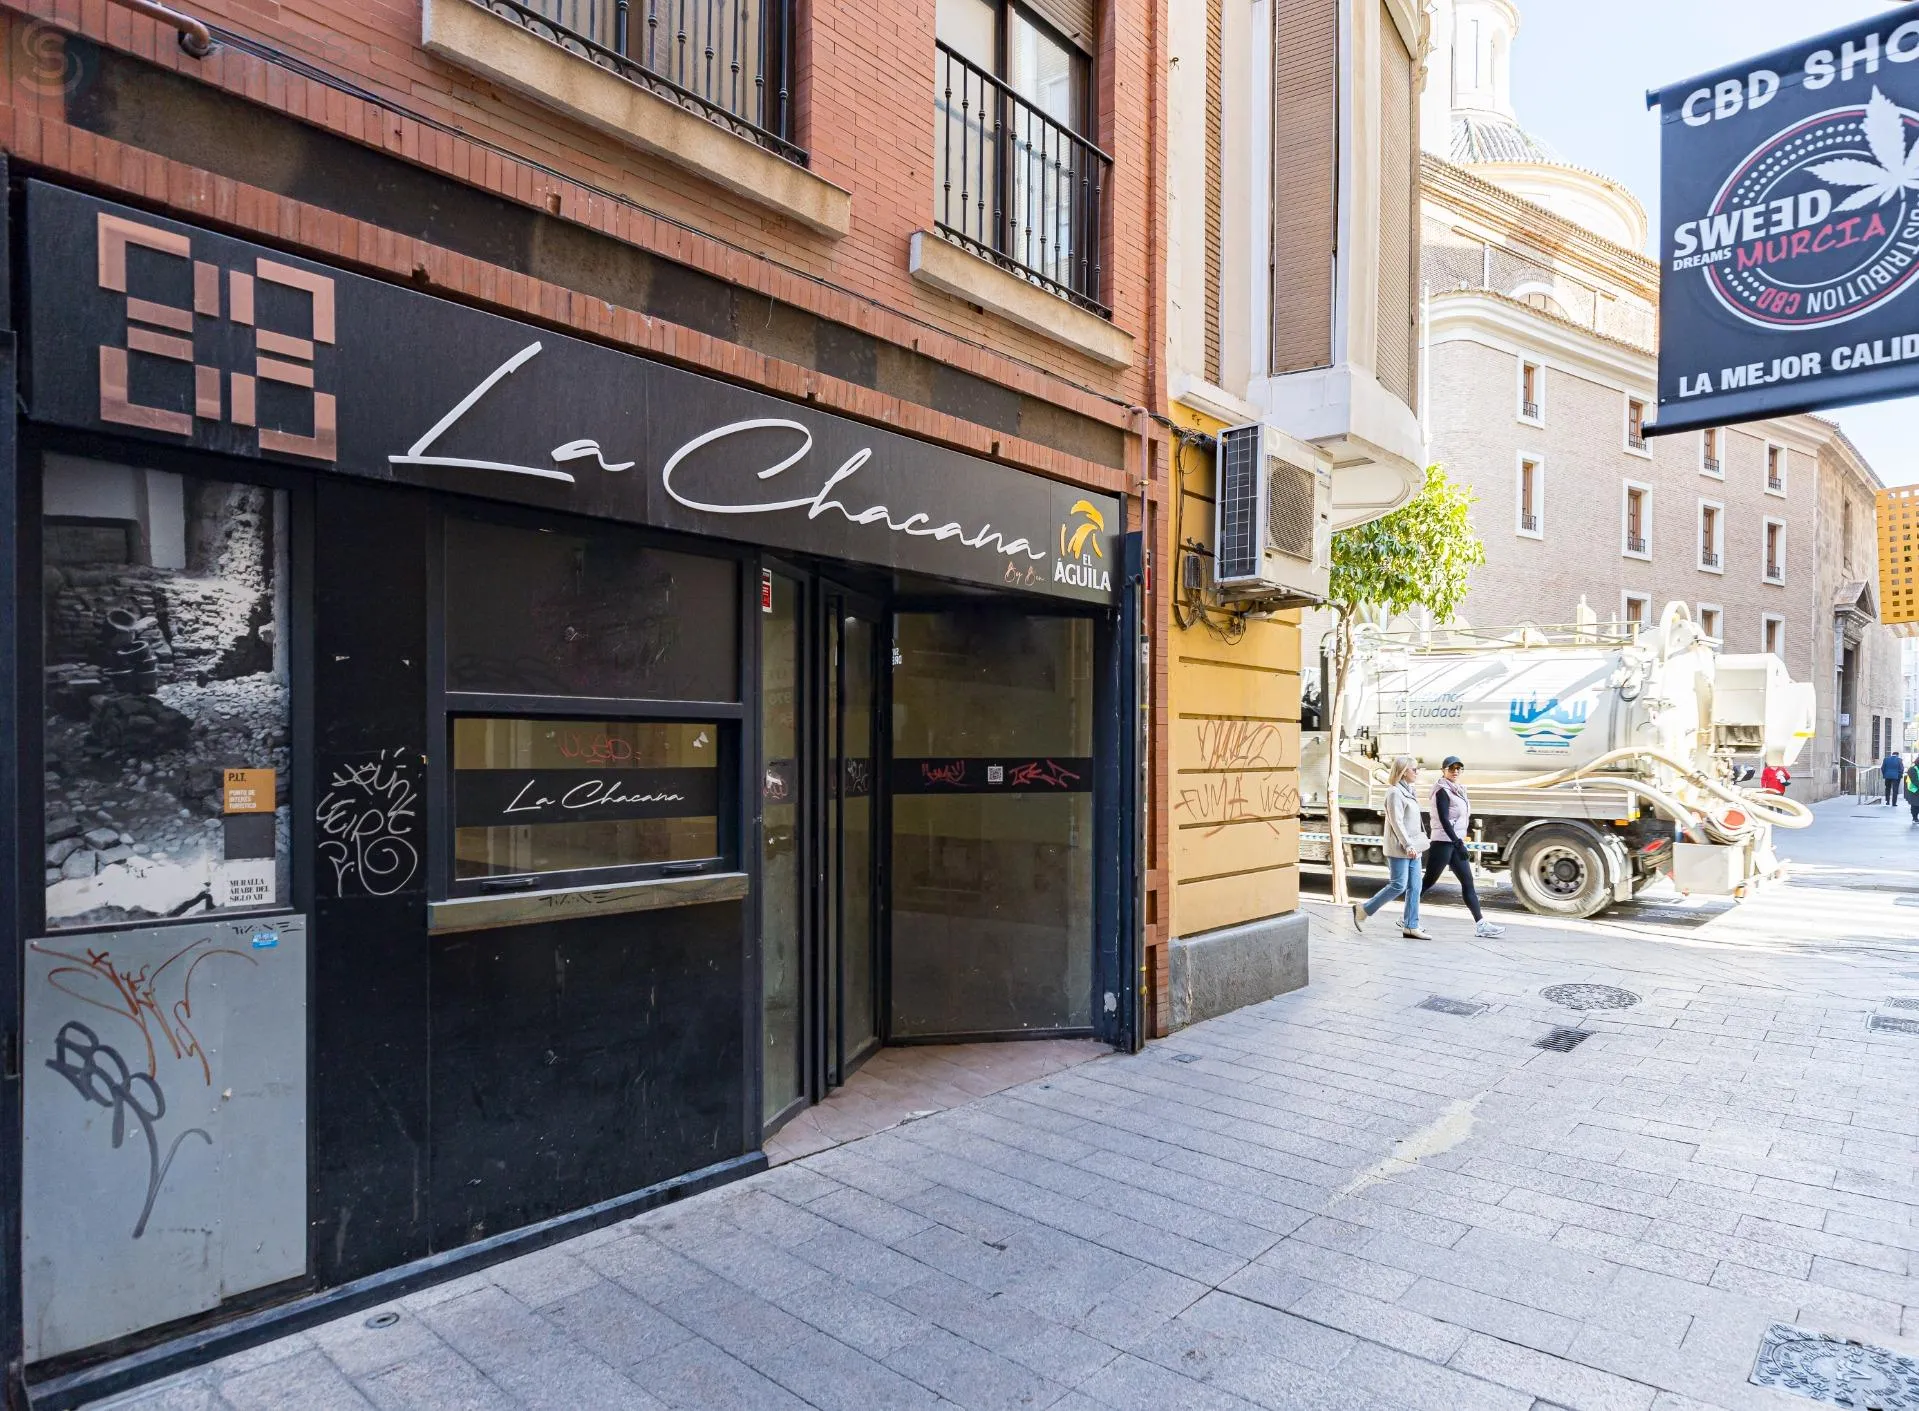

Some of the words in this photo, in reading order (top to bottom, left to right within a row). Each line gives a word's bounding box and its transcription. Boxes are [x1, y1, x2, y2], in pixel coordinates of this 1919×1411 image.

[1680, 69, 1780, 128] CBD
[1737, 212, 1887, 271] MURCIA
[1673, 246, 1733, 271] DREAMS
[1757, 287, 1801, 315] CBD
[1679, 372, 1713, 398] LA
[1720, 351, 1822, 390] MEJOR
[388, 340, 635, 483] La
[662, 418, 1047, 560] Chacana
[1053, 557, 1112, 592] ÁGUILA
[1083, 553, 1093, 567] EL
[503, 779, 556, 814] La
[562, 780, 685, 809] Chacana
[229, 878, 265, 887] MURALLA
[229, 894, 252, 902] SIGLO
[256, 885, 269, 893] DEL
